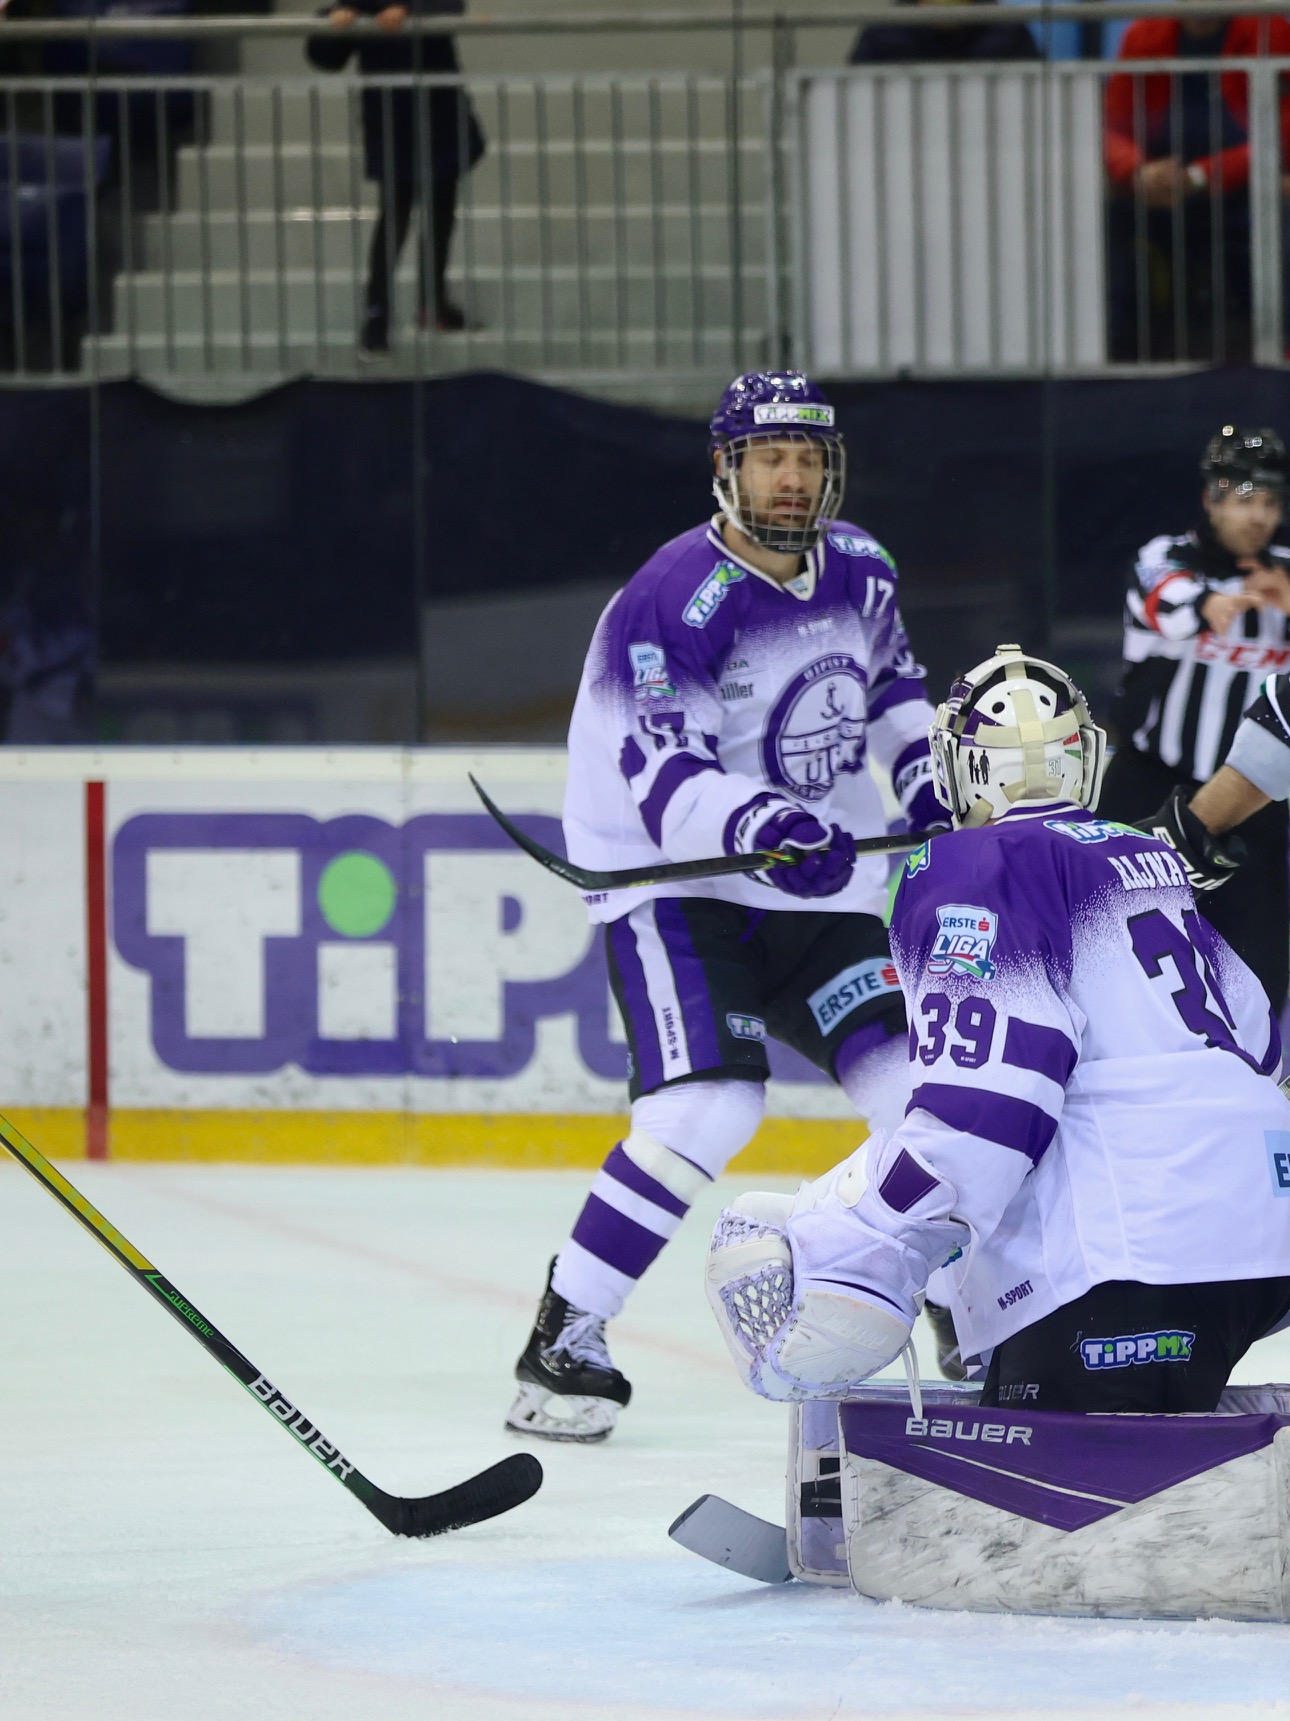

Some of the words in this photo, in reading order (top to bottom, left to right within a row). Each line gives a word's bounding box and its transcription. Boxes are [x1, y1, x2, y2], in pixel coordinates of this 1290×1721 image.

[862, 576, 894, 618] 17
[1107, 852, 1186, 891] RAJNA
[942, 917, 977, 930] ERSTE
[933, 935, 990, 962] LIGA
[816, 971, 882, 1026] ERSTE
[919, 993, 997, 1069] 39
[997, 1279, 1034, 1311] M-SPORT
[905, 1417, 1033, 1446] BAUER
